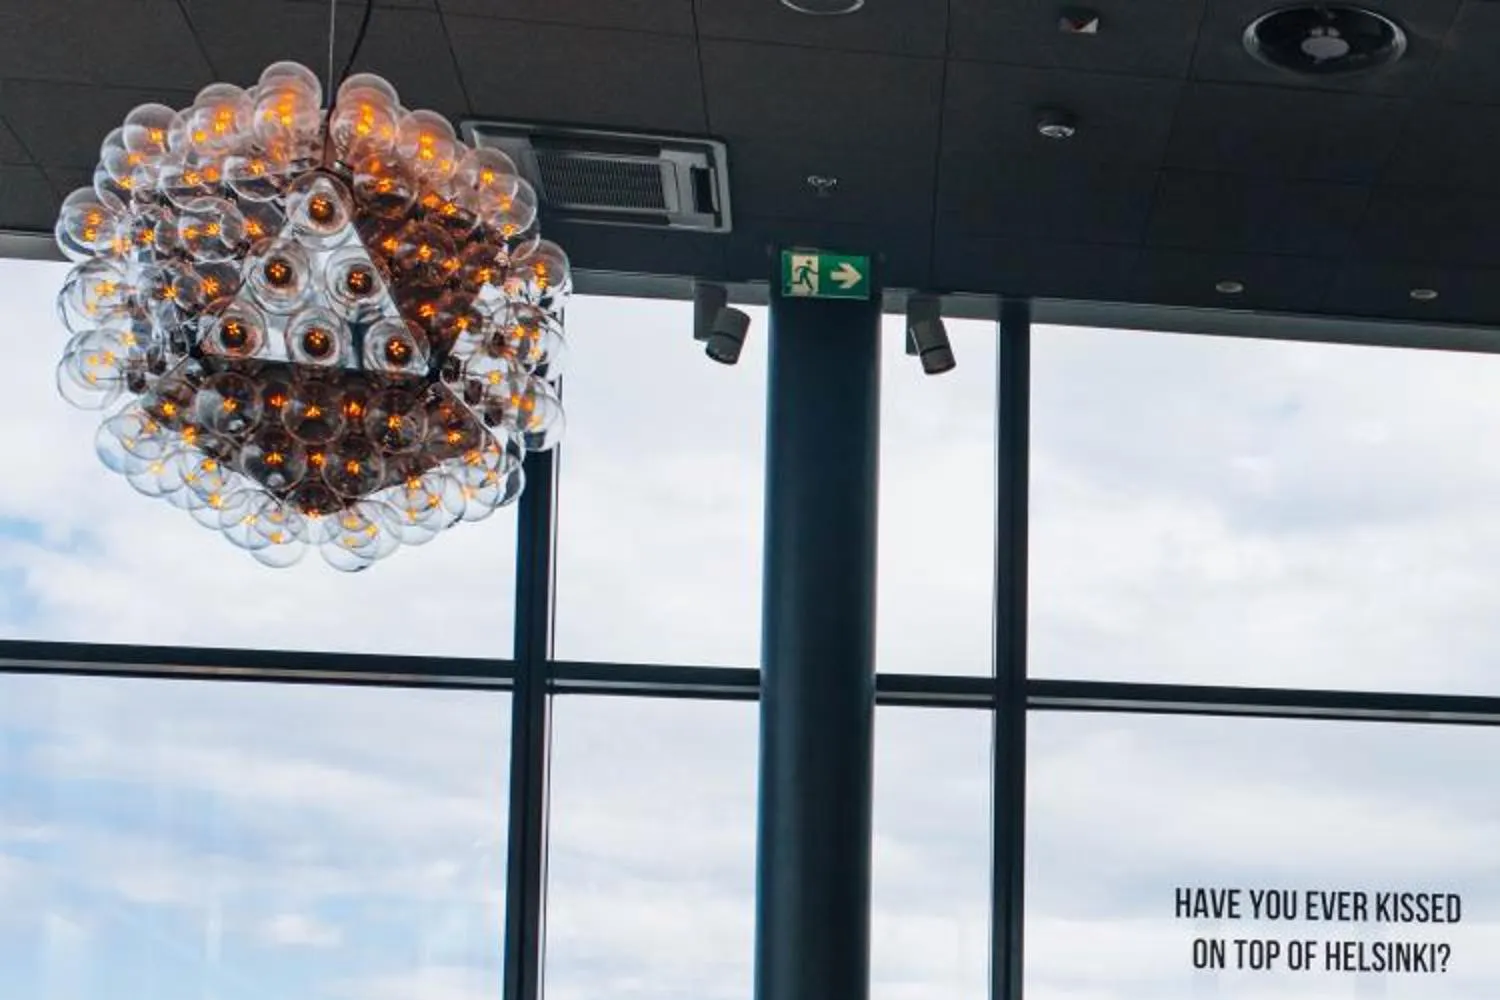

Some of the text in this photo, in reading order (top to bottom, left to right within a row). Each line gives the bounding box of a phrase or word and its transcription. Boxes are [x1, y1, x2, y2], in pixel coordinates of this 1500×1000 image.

[1175, 887, 1461, 924] HAVE YOU EVER KISSED
[1193, 938, 1451, 973] ON TOP OF HELSINKI?
